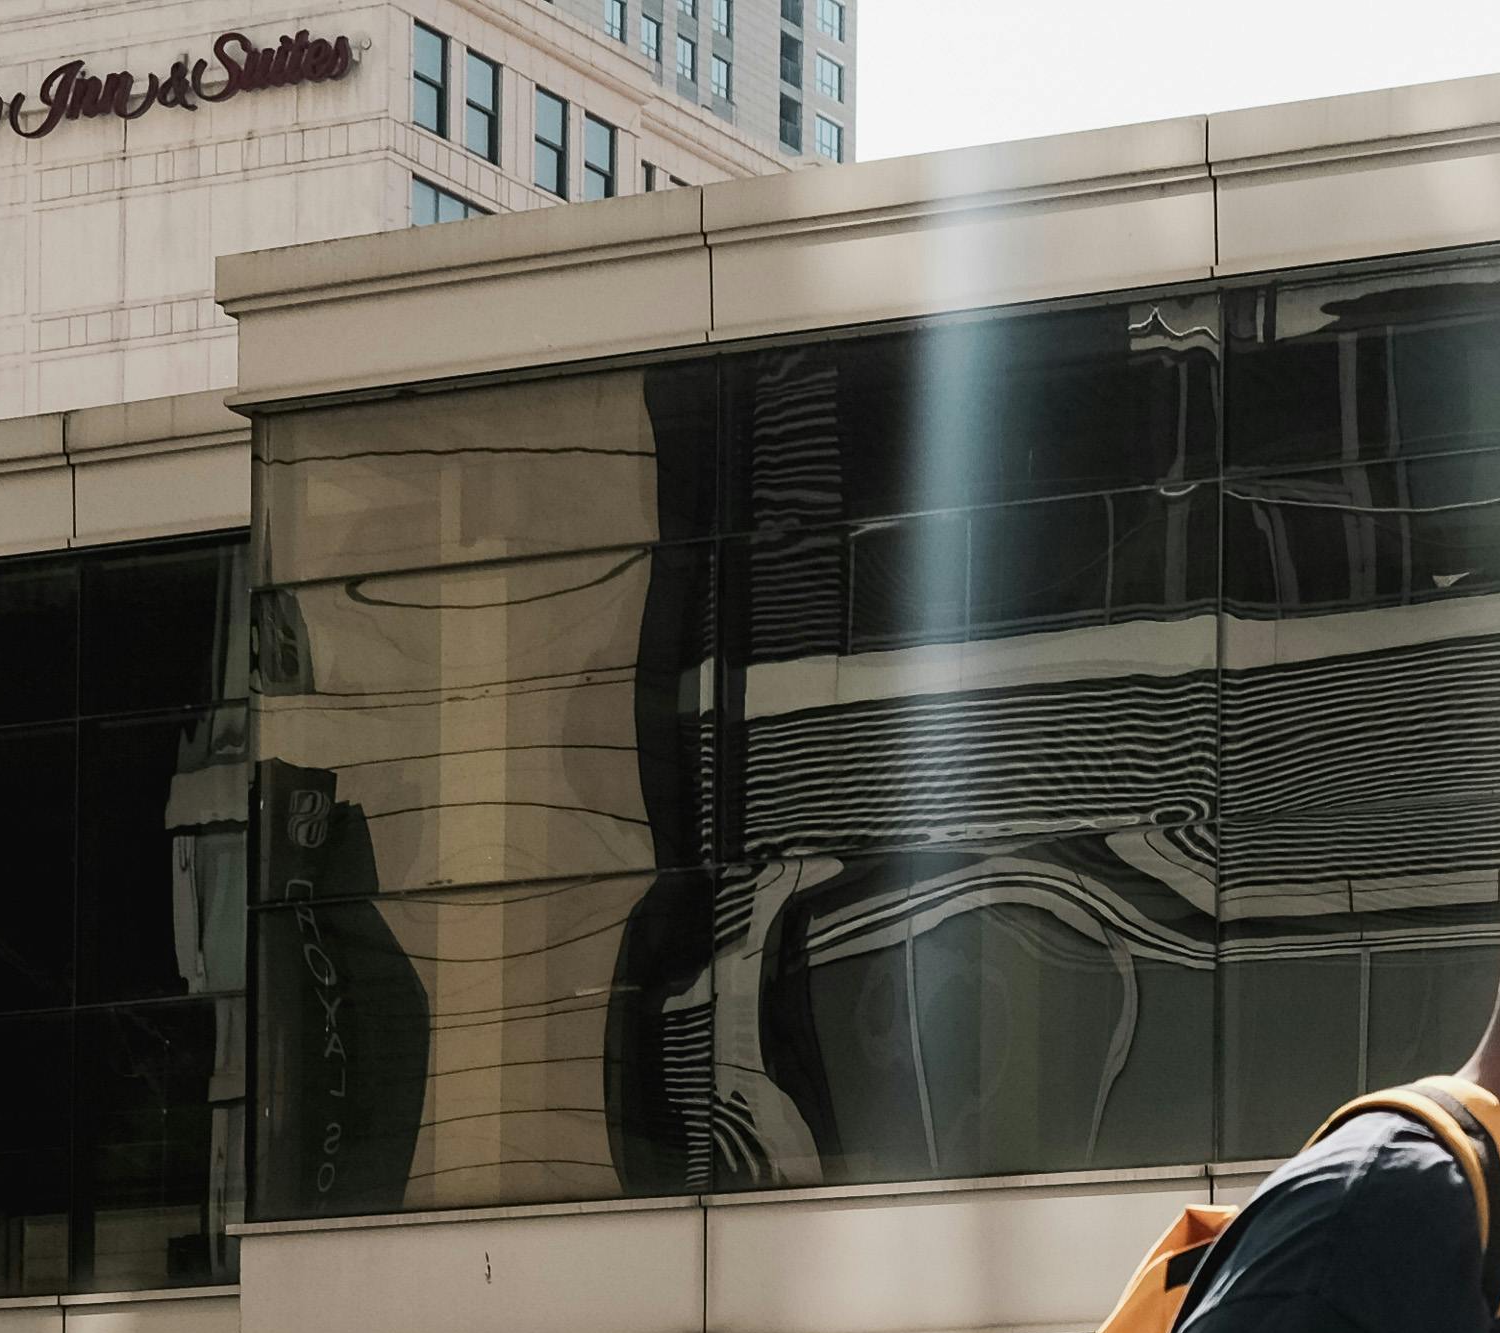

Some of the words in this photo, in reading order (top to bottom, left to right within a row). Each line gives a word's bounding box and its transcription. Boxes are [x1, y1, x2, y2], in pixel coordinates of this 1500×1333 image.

[11, 60, 158, 139] Inn
[157, 62, 197, 111] &
[192, 29, 350, 102] Suites
